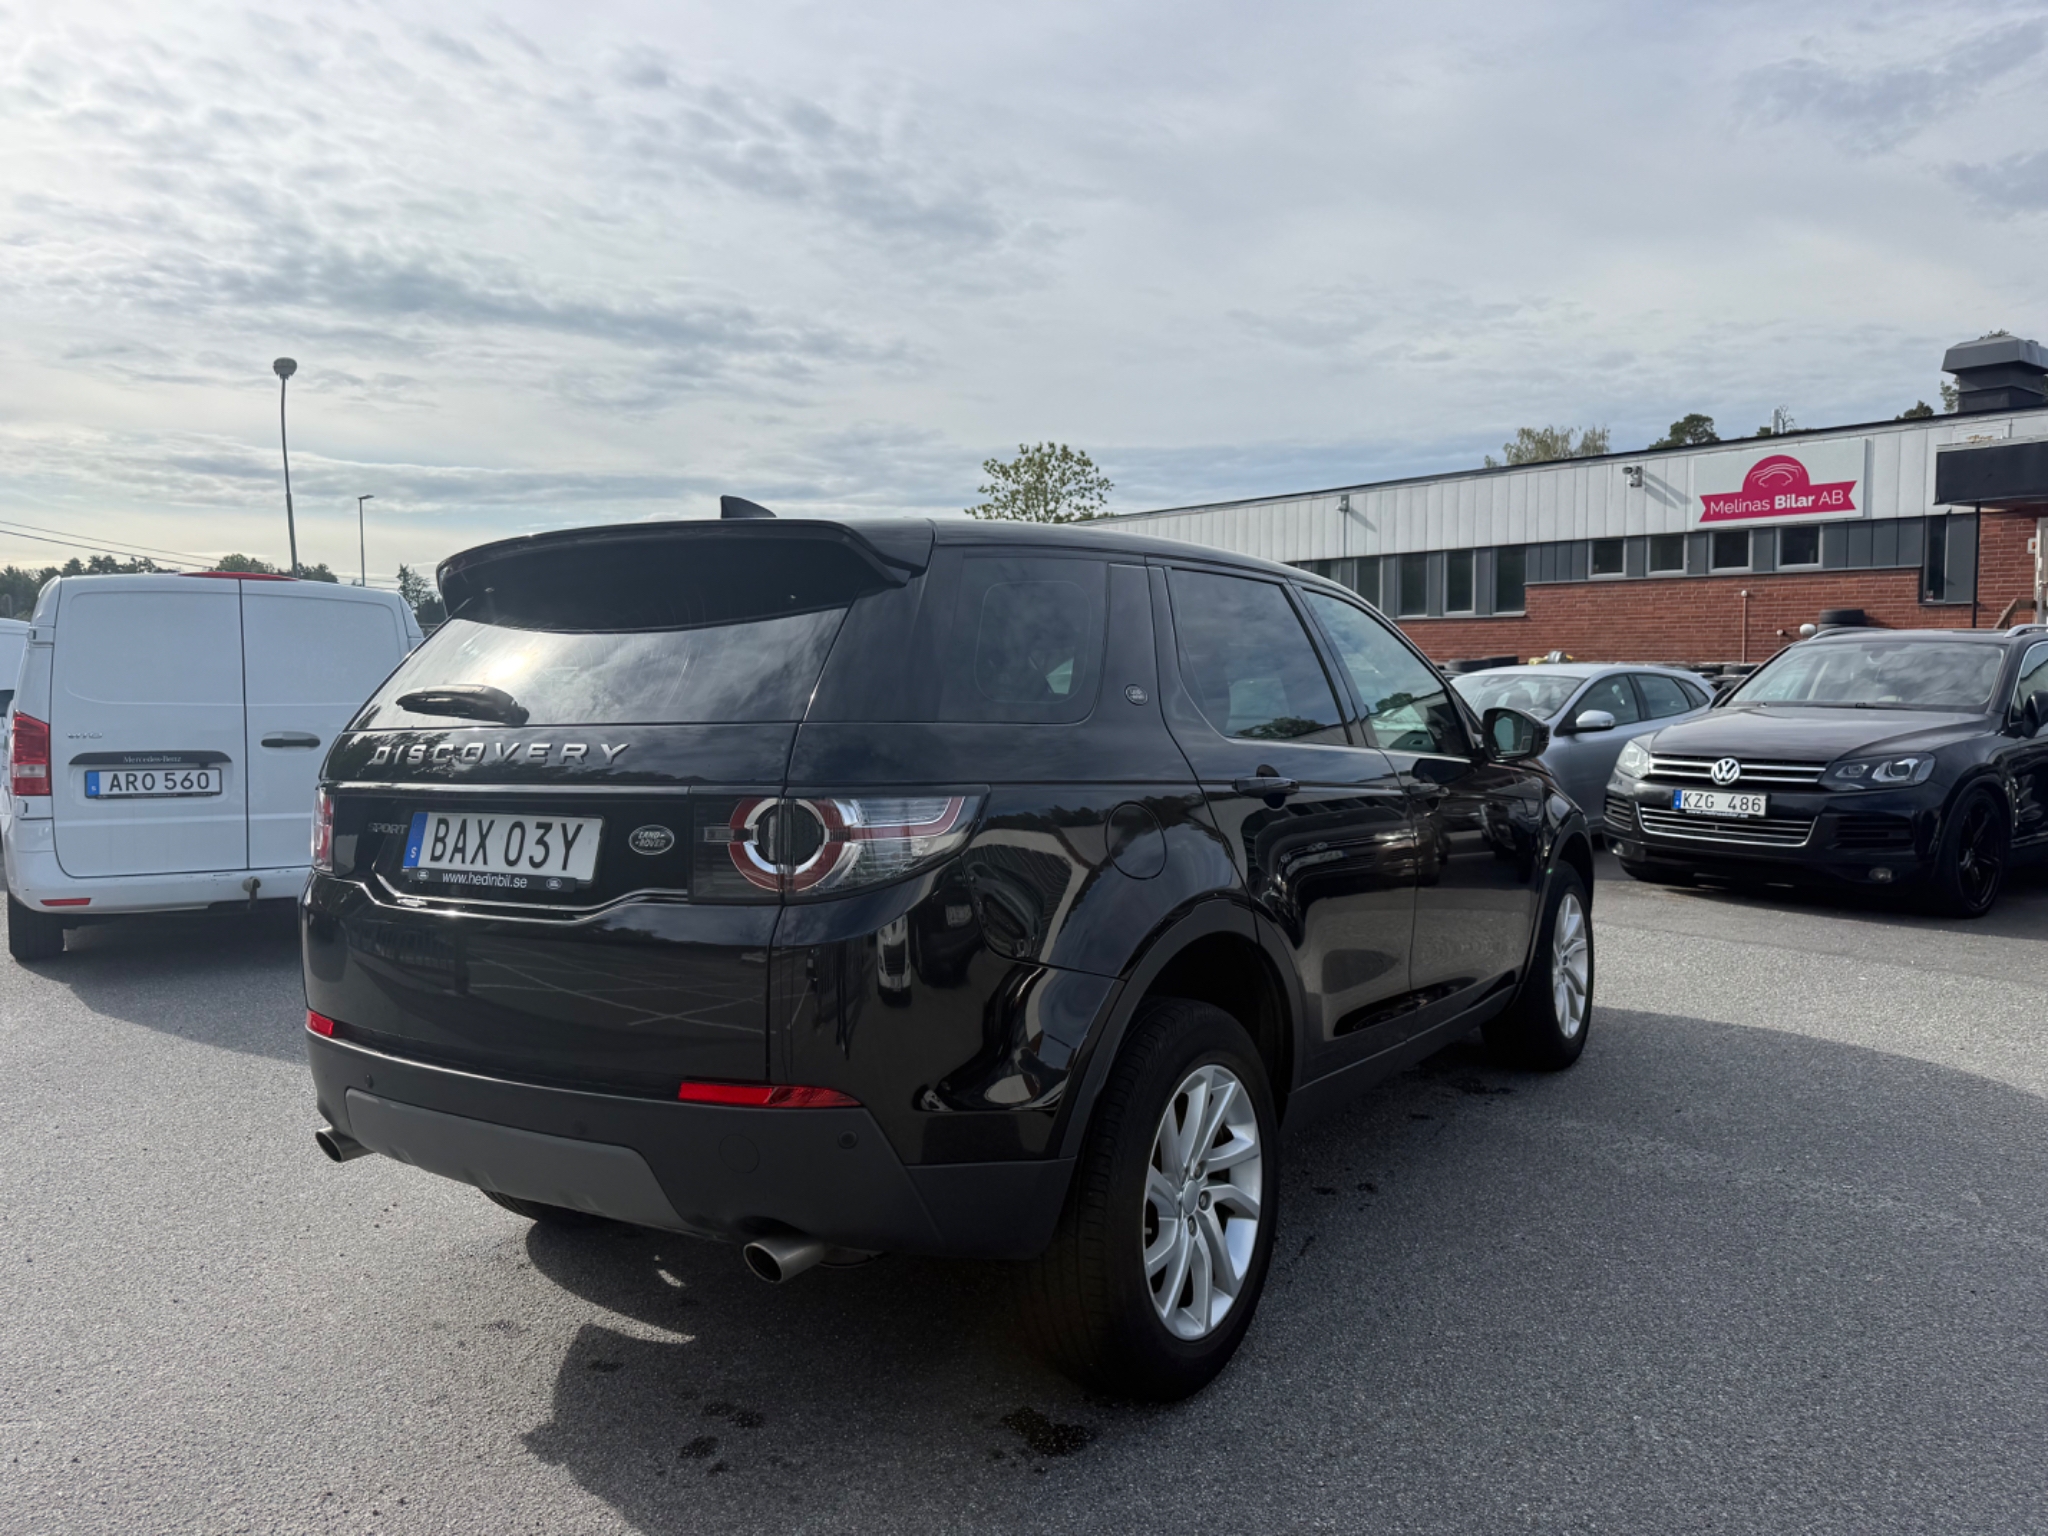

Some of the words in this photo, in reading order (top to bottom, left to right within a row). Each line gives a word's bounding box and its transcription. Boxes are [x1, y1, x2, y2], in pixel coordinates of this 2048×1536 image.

[1710, 499, 1771, 515] Melinas
[1774, 494, 1816, 510] Bilar
[1818, 489, 1844, 506] AB
[372, 742, 630, 766] DISCOVERY
[108, 772, 156, 793] ARO
[164, 772, 210, 790] 560
[1683, 793, 1715, 809] KZG
[1727, 796, 1761, 813] 486
[368, 822, 408, 834] SPORT
[429, 818, 496, 866] BAX
[503, 821, 584, 871] 03Y
[442, 872, 528, 888] www.hedinbil.se
